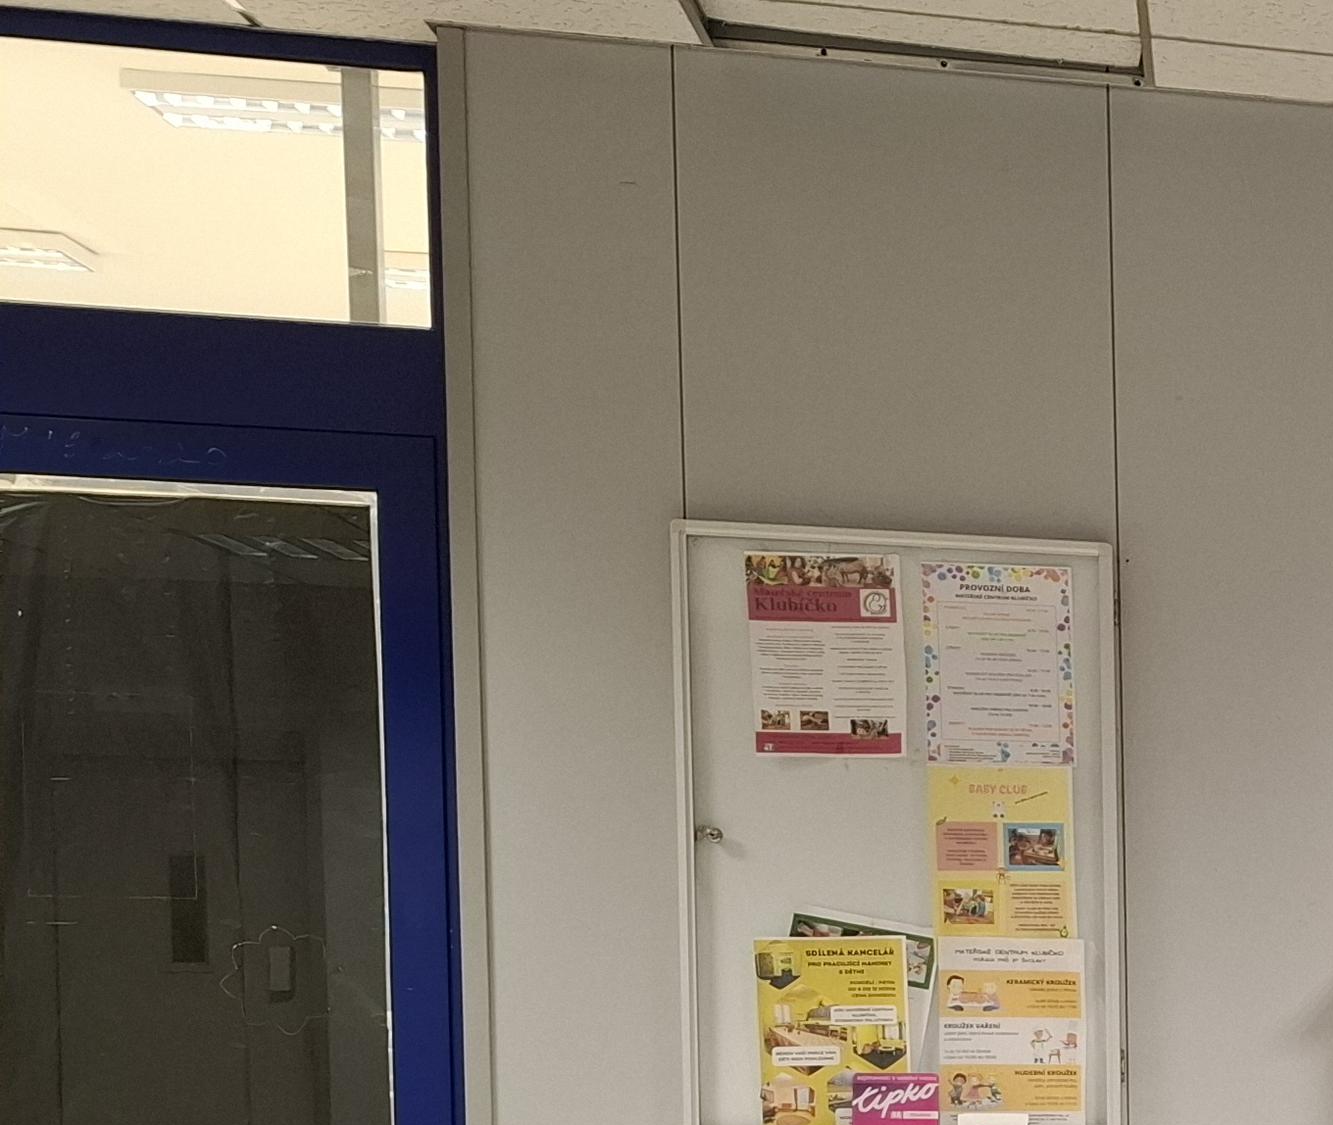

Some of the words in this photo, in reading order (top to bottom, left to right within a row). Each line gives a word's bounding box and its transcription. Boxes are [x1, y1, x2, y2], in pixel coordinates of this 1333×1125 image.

[960, 583, 1005, 592] PROVOZNÍ
[1006, 585, 1031, 593] DOBA
[805, 949, 845, 957] SDÍLENÁ
[847, 948, 895, 957] KANCELÁŘ
